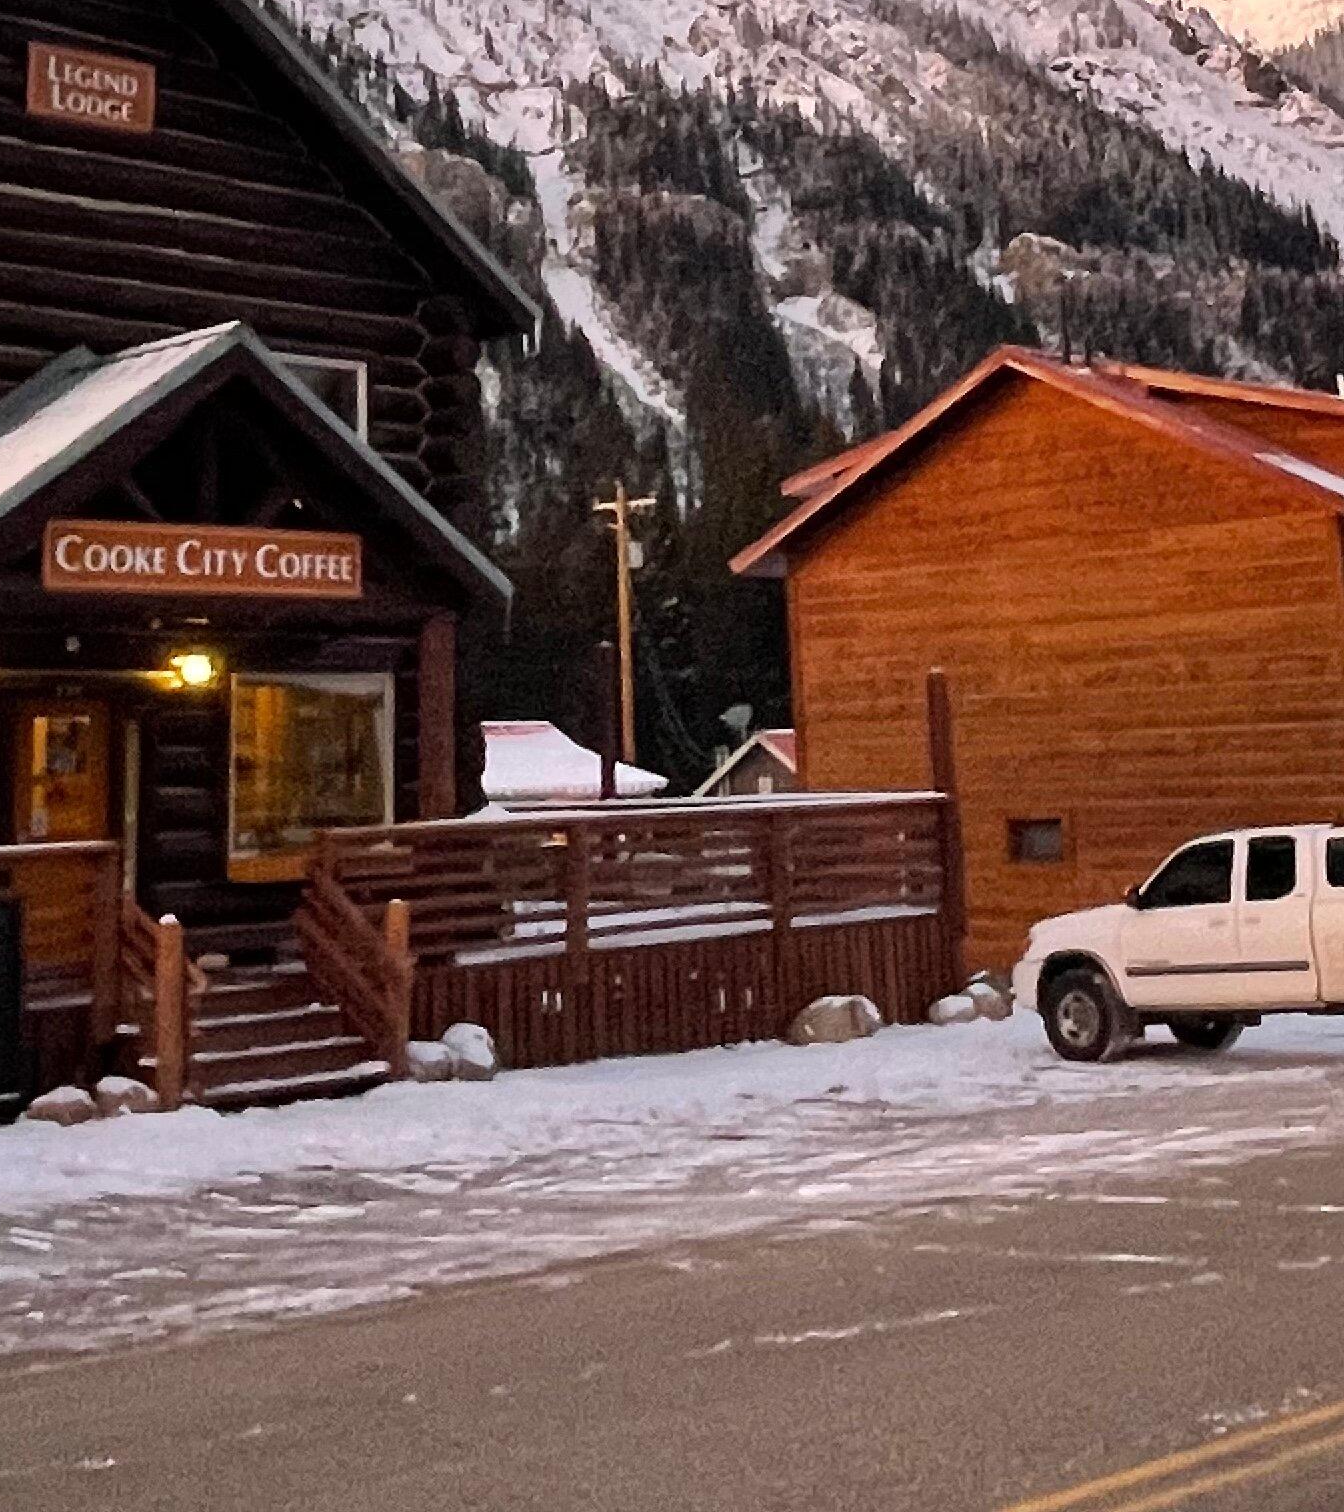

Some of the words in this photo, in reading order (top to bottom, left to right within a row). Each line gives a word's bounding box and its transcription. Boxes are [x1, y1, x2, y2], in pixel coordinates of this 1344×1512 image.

[47, 55, 139, 97] LEGEND
[51, 83, 135, 123] LODGE
[54, 534, 167, 575] COOKE
[175, 539, 248, 576] CITY
[255, 543, 354, 582] COFFEE
